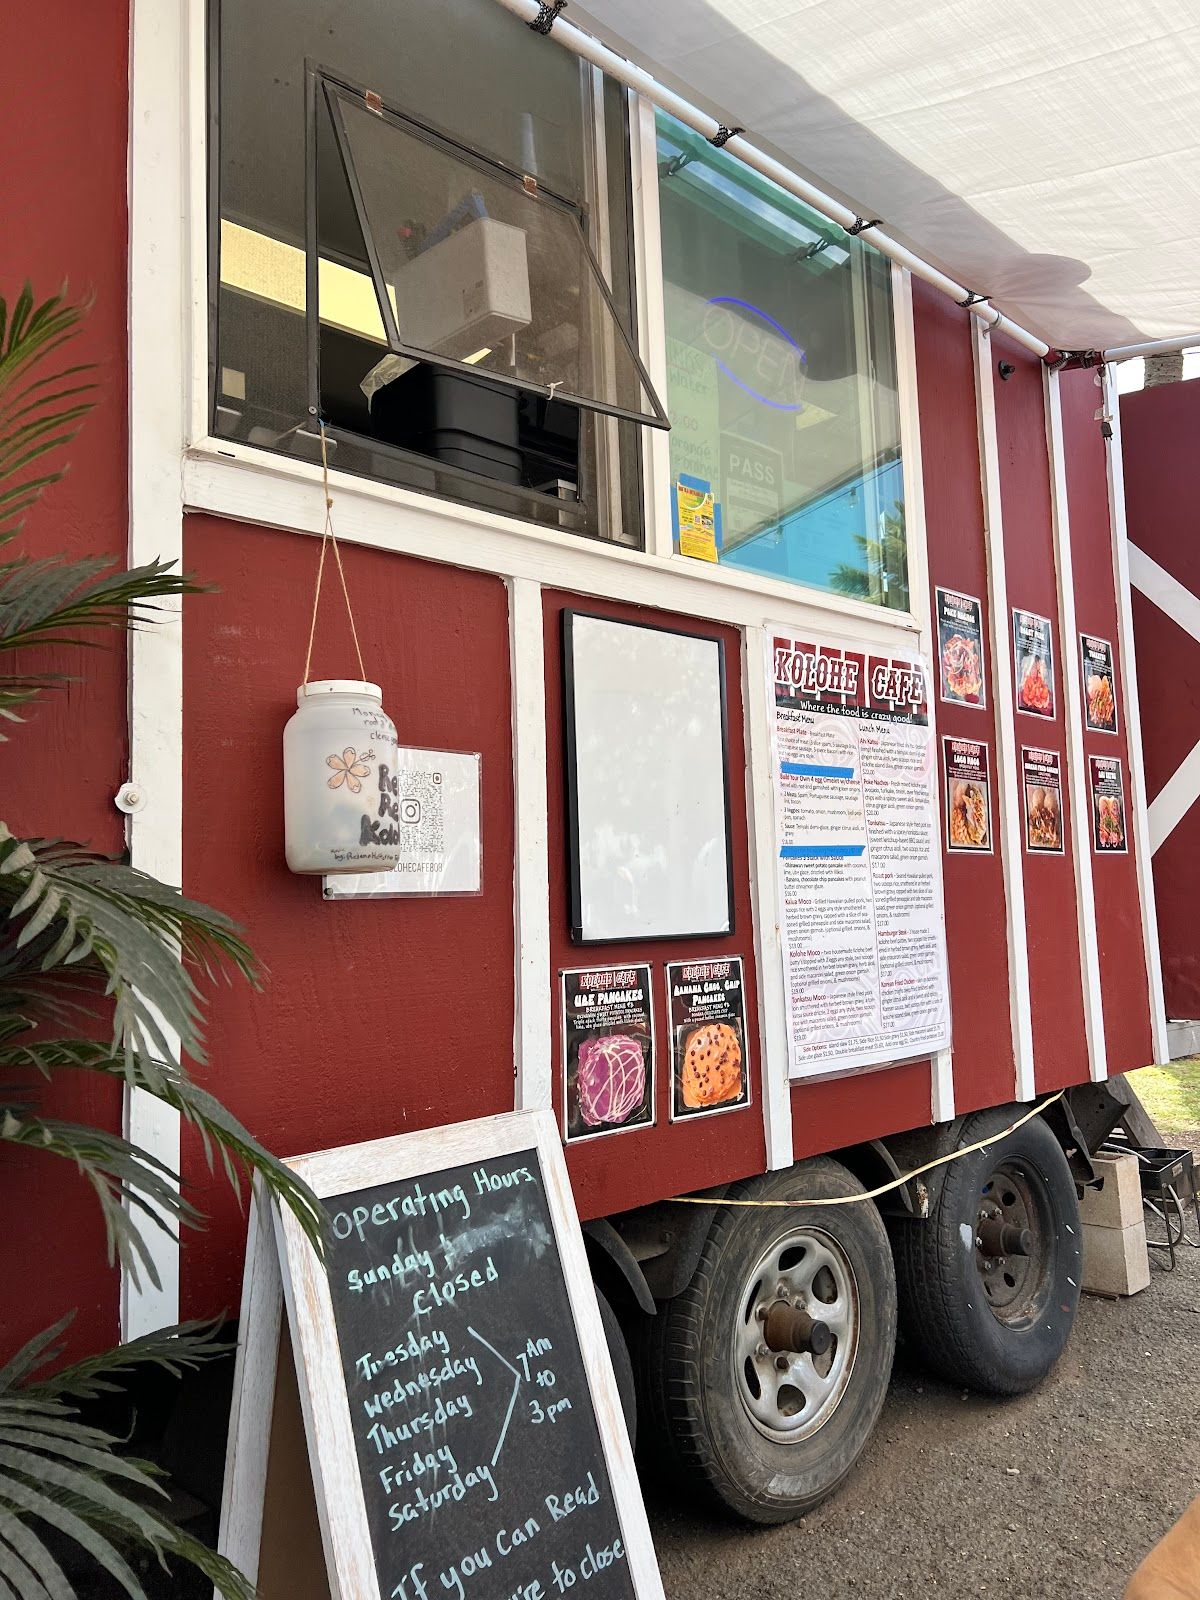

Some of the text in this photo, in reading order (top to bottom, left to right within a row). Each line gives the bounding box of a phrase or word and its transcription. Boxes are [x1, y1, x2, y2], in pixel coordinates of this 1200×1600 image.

[703, 306, 806, 401] OPEN
[729, 453, 775, 485] PASS
[775, 648, 922, 705] KOLOHE CAFE
[776, 710, 815, 724] Breakfast Menu
[800, 700, 913, 726] Where the food is crazy good!
[858, 724, 875, 733] Lunch
[386, 862, 443, 873] OHECAFE808
[597, 988, 643, 1005] PANCAKES
[692, 993, 726, 1006] PANCAKES
[332, 1166, 536, 1242] Operating Hours
[347, 1250, 436, 1292] Sunday
[412, 1256, 499, 1315] Closed
[355, 1330, 450, 1381] Tuesday
[366, 1394, 473, 1455] Thursday
[379, 1444, 458, 1495] Friday
[388, 1465, 499, 1532] Saturday
[440, 1547, 492, 1600] you
[545, 1471, 600, 1522] Read
[551, 1560, 577, 1594] to
[580, 1538, 625, 1580] close
